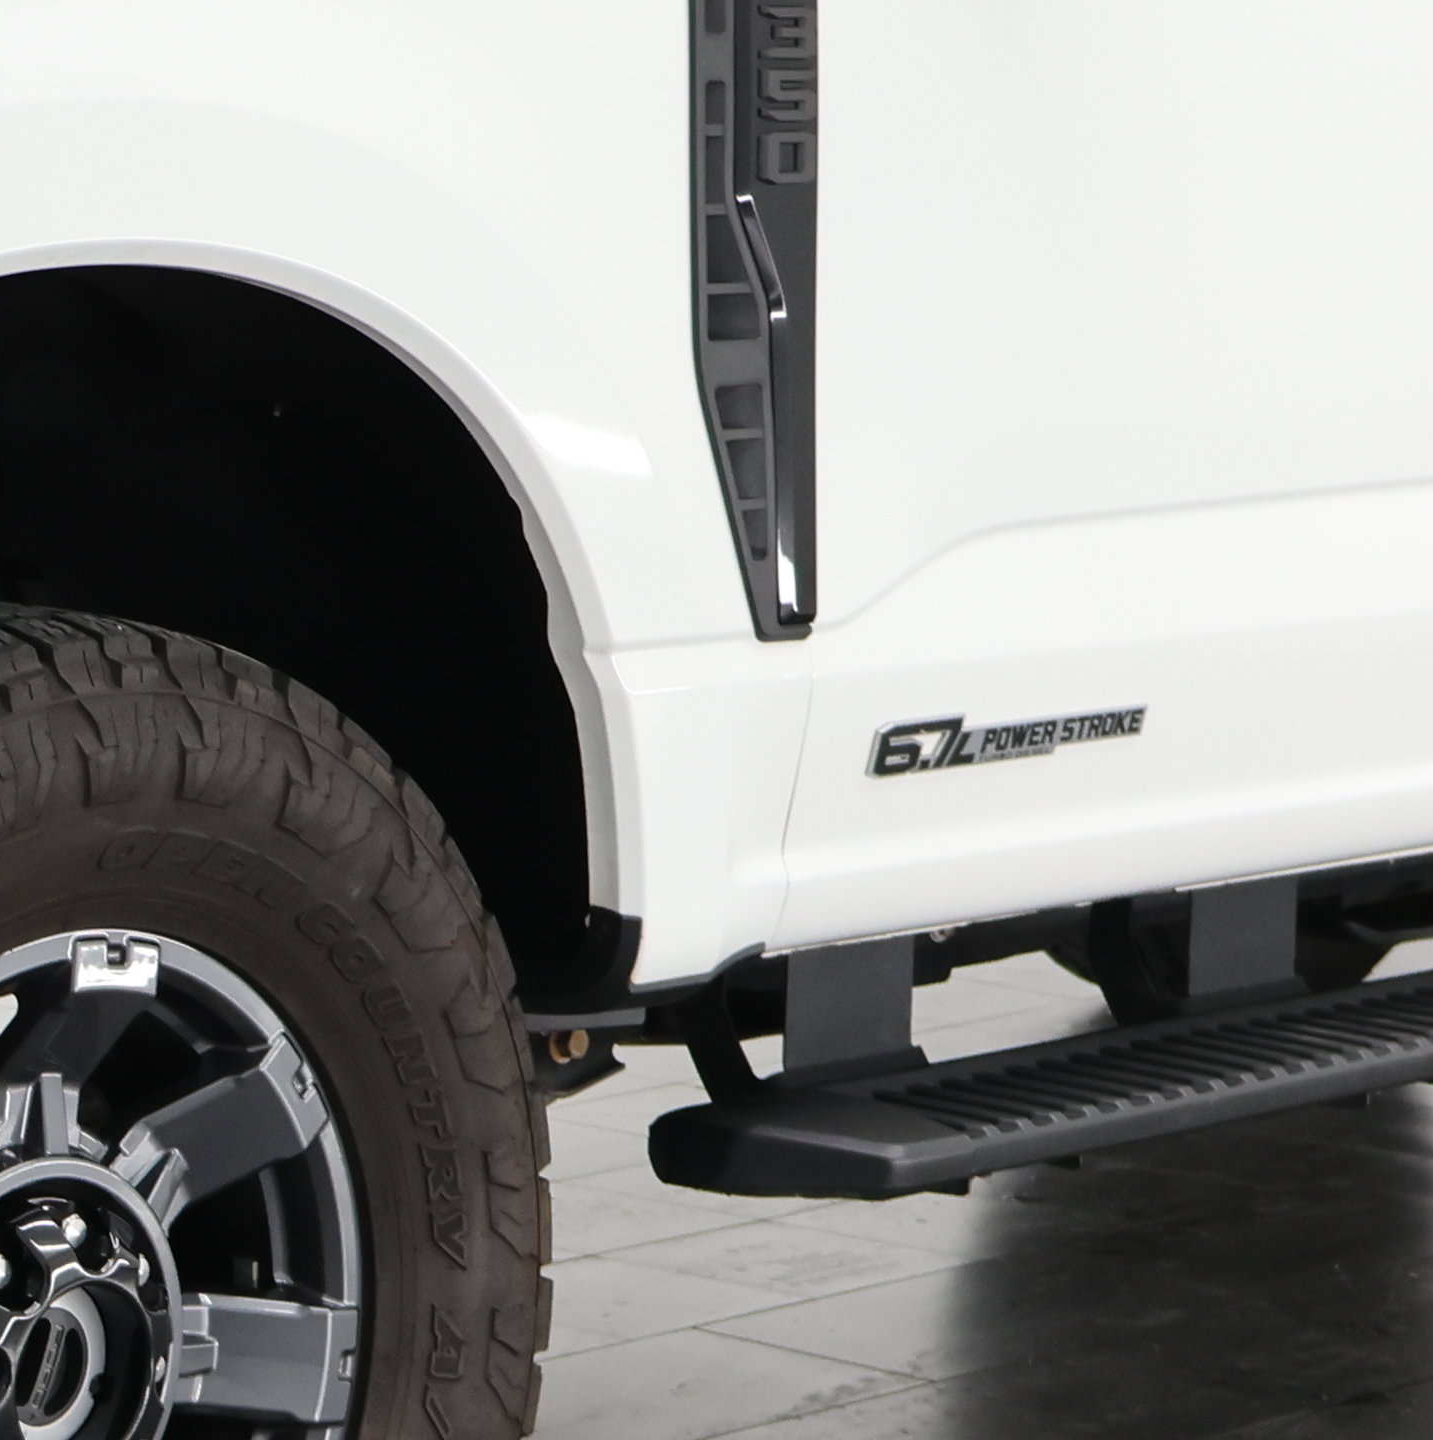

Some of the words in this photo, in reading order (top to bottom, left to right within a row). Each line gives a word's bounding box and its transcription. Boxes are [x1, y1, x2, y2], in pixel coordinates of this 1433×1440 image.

[980, 720, 1058, 754] POWER
[1060, 709, 1146, 742] STROKE
[94, 826, 309, 910] OPEN
[293, 901, 468, 1272] COUNTRY
